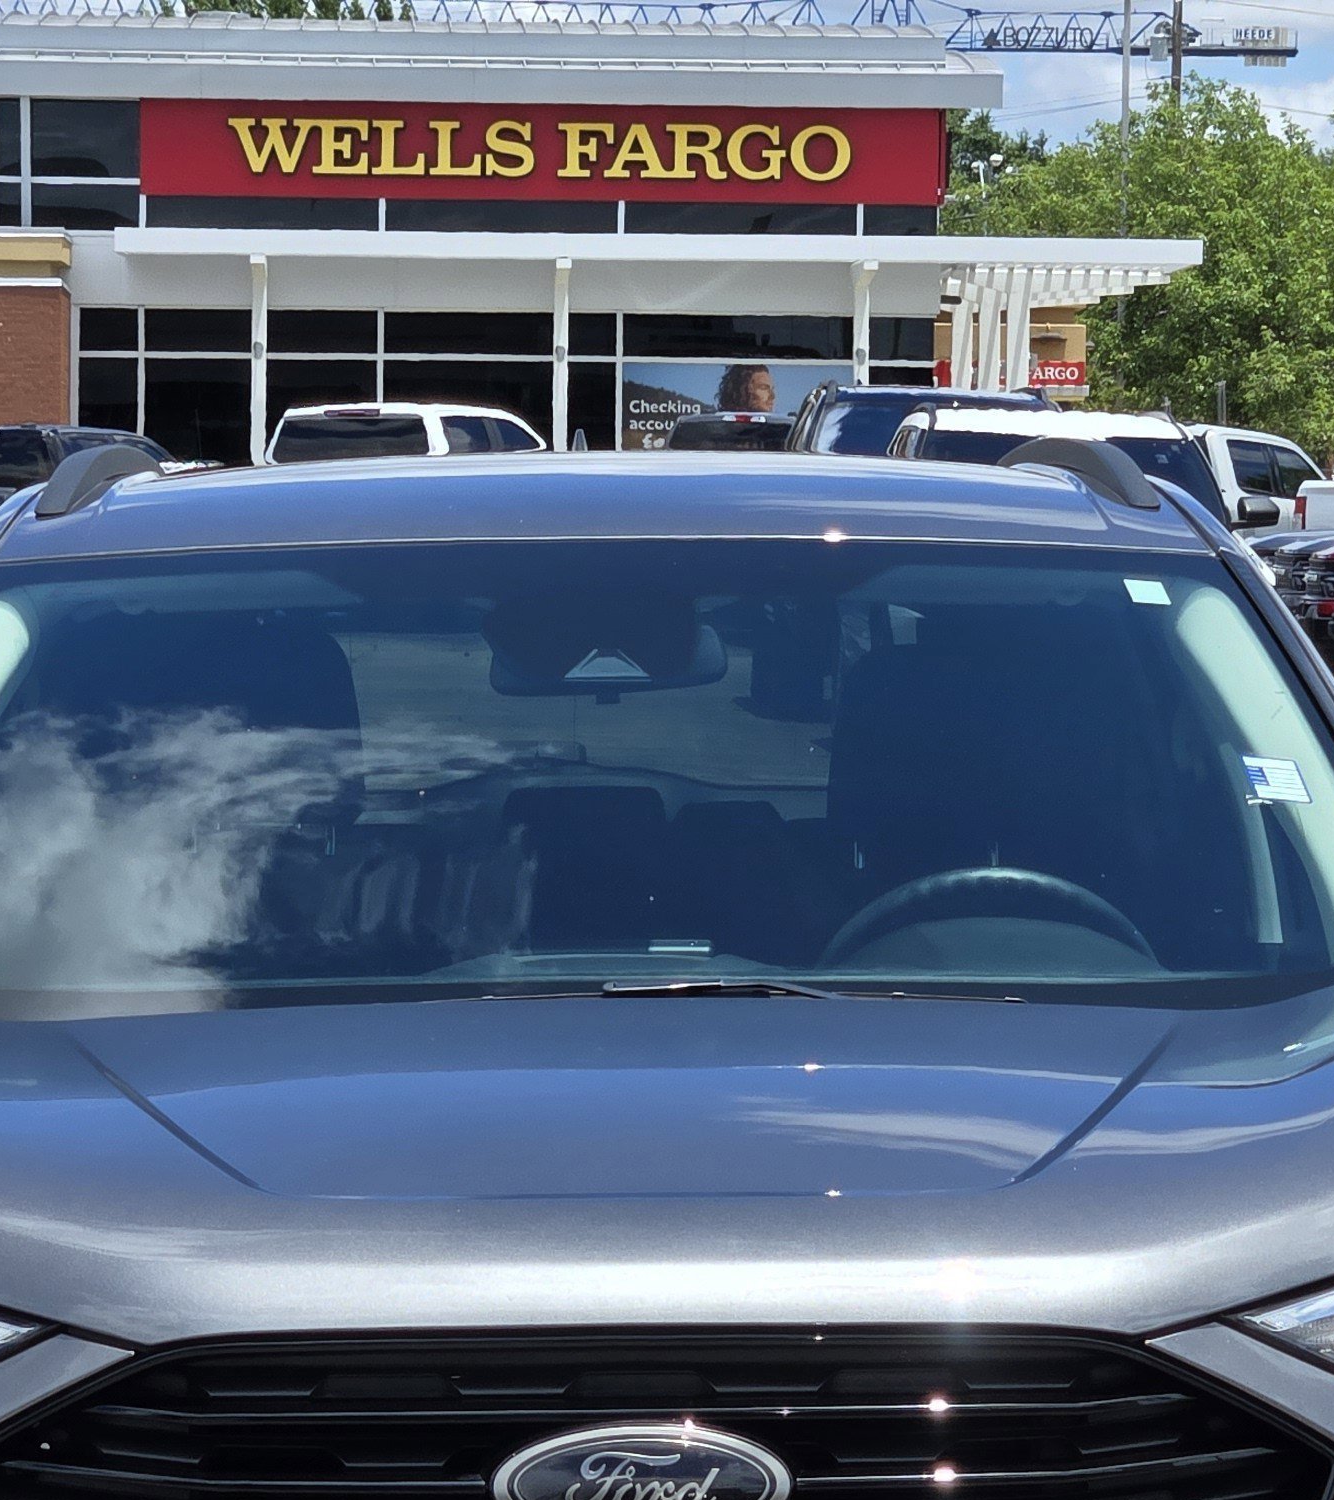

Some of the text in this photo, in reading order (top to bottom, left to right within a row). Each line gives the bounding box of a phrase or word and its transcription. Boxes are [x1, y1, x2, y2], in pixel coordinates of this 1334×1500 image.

[1003, 26, 1094, 48] BOZZUTO
[227, 117, 852, 182] WELLS FARGO
[1028, 366, 1079, 380] ARGO
[629, 399, 701, 415] Checking
[629, 419, 675, 431] accou
